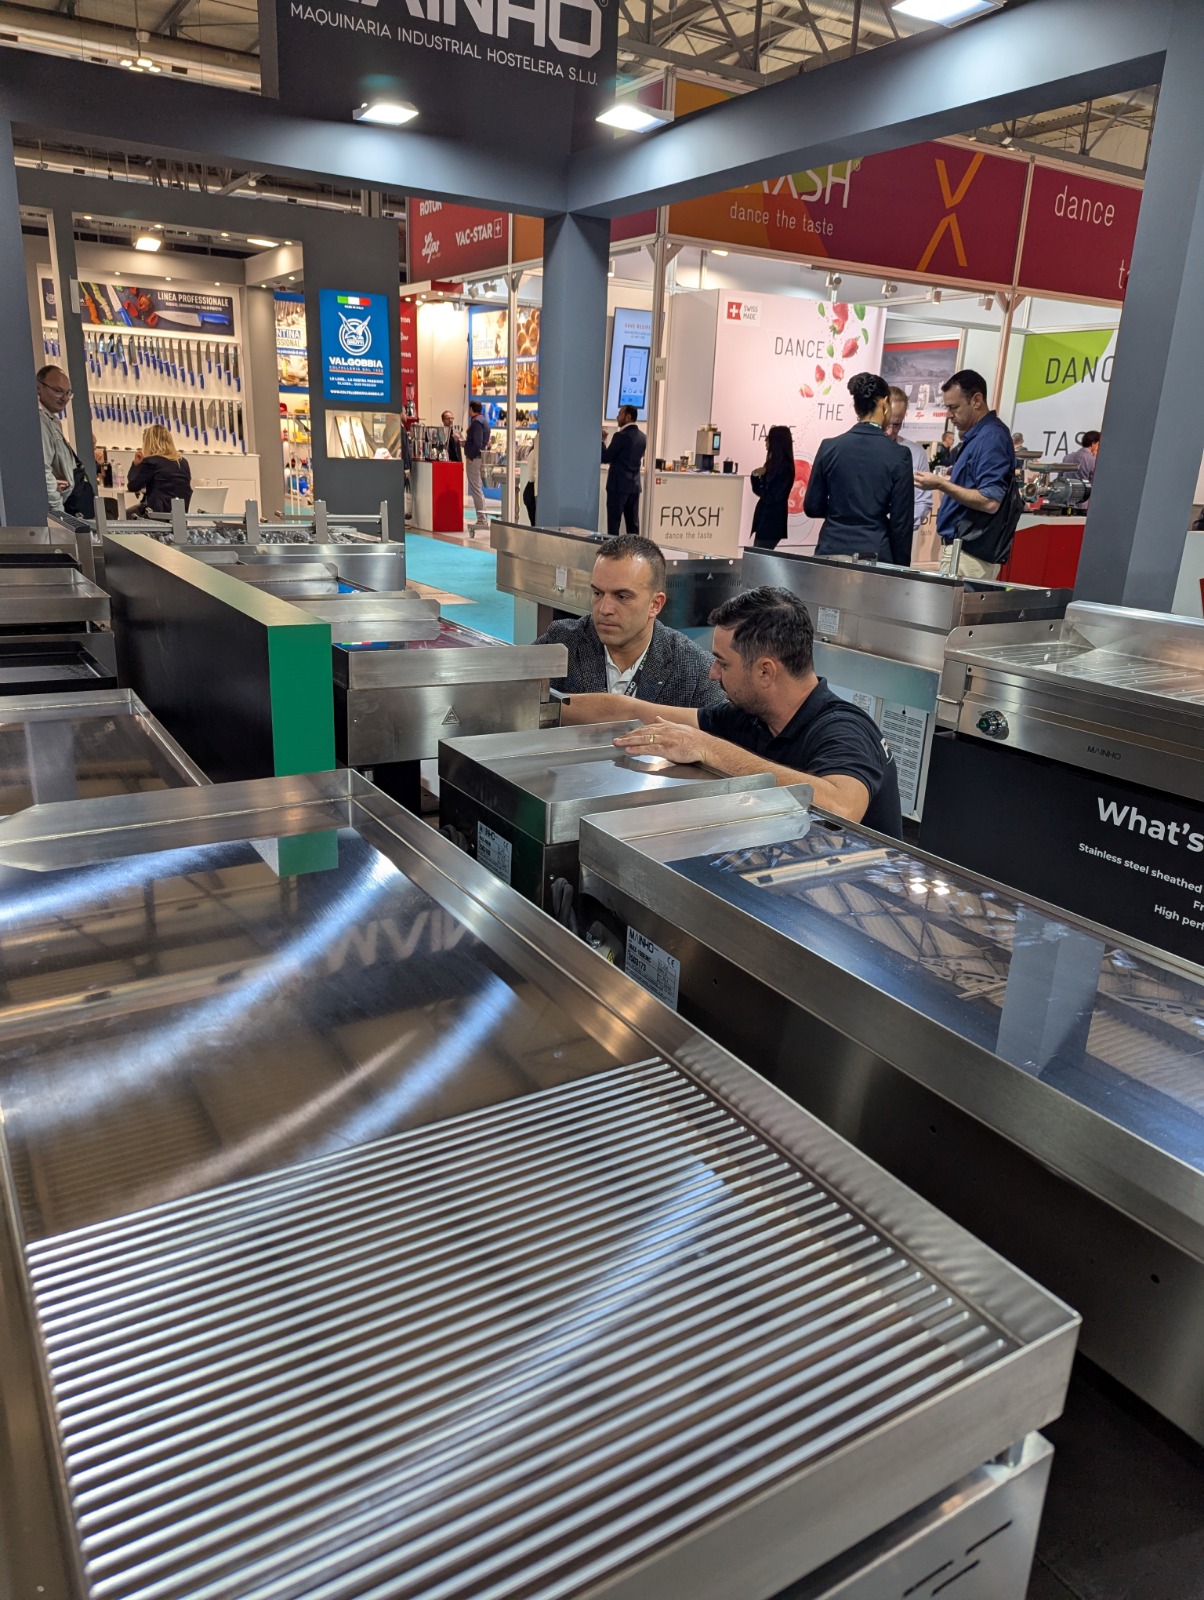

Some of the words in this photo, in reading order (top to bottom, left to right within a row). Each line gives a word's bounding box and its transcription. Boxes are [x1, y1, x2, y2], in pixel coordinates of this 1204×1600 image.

[290, 2, 392, 39] MAQUINARIA
[397, 27, 482, 59] INDUSTRIAL
[487, 48, 564, 78] HOSTELERA
[568, 67, 598, 85] S.L.U.
[1054, 185, 1115, 227] dance
[730, 202, 769, 224] dance
[776, 209, 796, 229] the
[803, 214, 834, 235] taste
[455, 223, 493, 246] VAC-STAR
[157, 292, 177, 302] LINEA
[179, 295, 229, 307] PROFESSIONALE
[743, 305, 758, 313] SWISS
[774, 337, 825, 359] DANCE
[328, 357, 383, 368] VALGOBBIA
[817, 403, 844, 421] THE
[660, 506, 720, 527] FRXSH
[1087, 745, 1122, 761] MAINHO
[1078, 842, 1123, 865] Stainless
[1123, 859, 1150, 875] steel
[1151, 869, 1203, 894] sheathed
[1154, 904, 1180, 921] High
